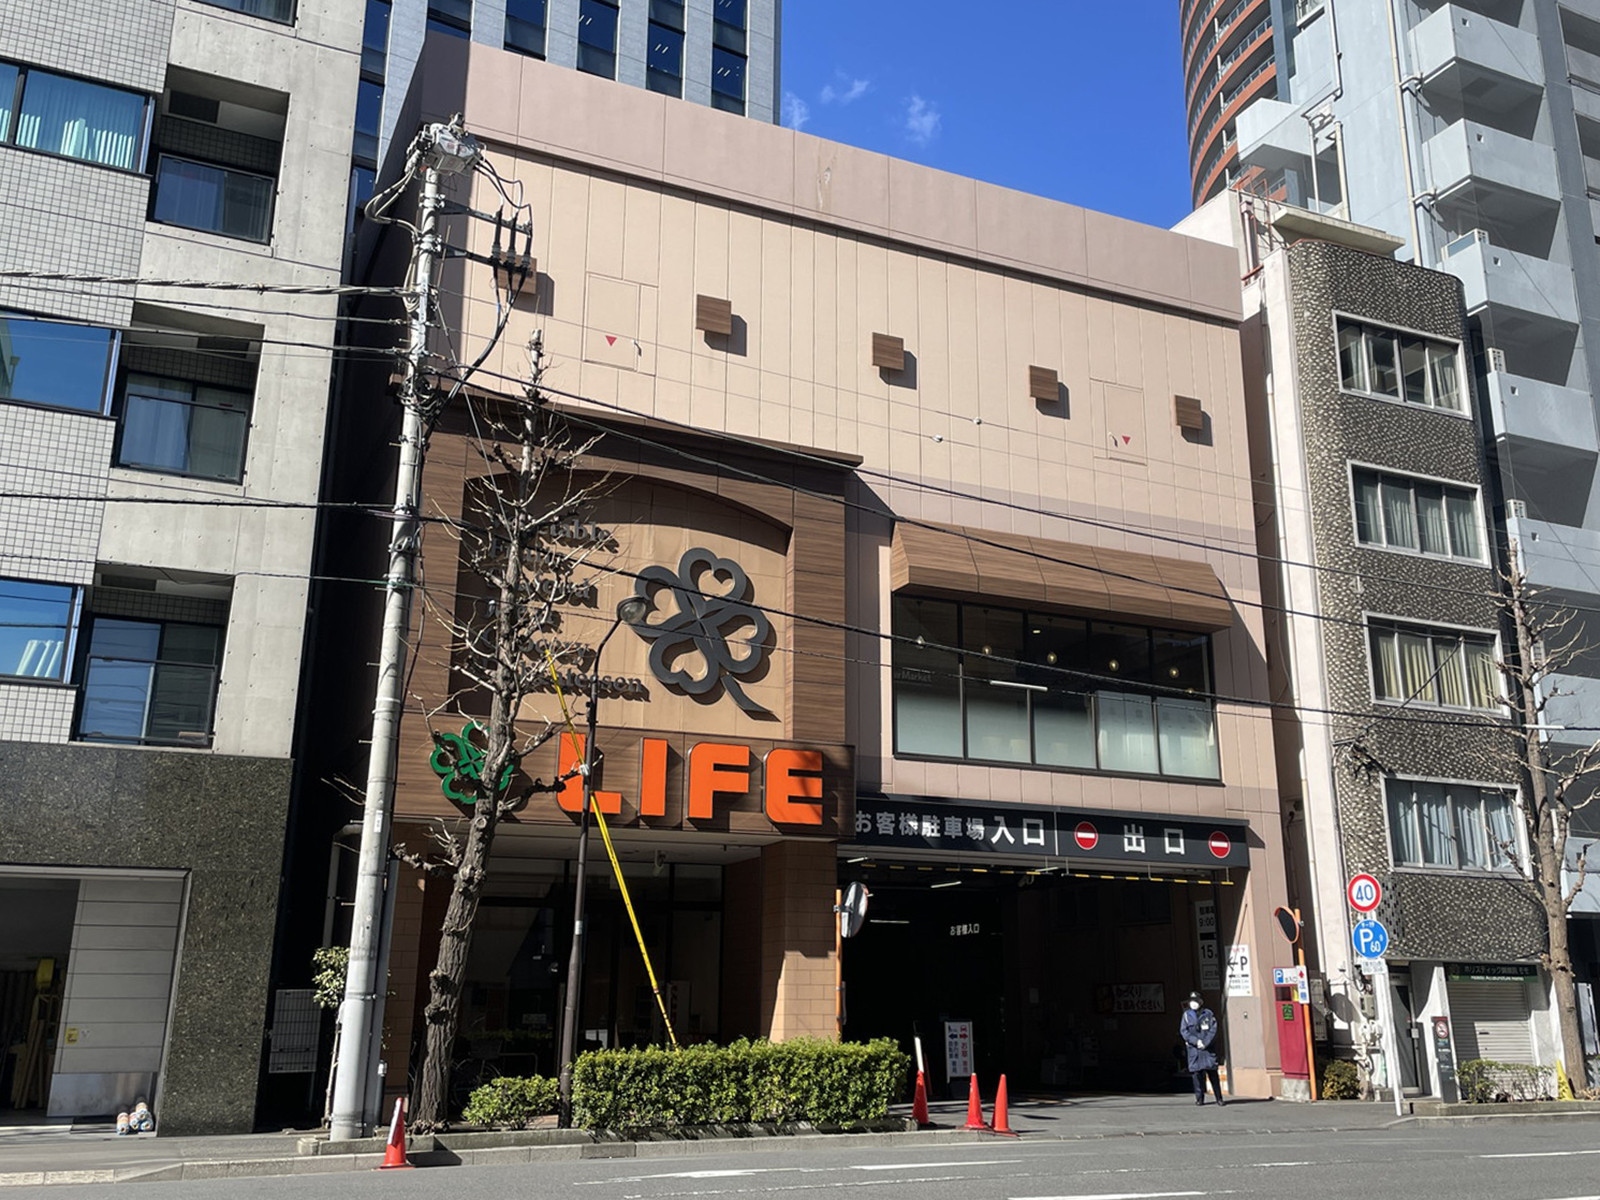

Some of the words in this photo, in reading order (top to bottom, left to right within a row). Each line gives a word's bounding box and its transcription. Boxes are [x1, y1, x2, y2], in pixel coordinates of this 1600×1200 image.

[556, 731, 823, 826] LIFE
[1123, 823, 1186, 856] 出口
[1356, 884, 1374, 902] 40
[1359, 928, 1374, 954] P
[1240, 955, 1248, 971] P
